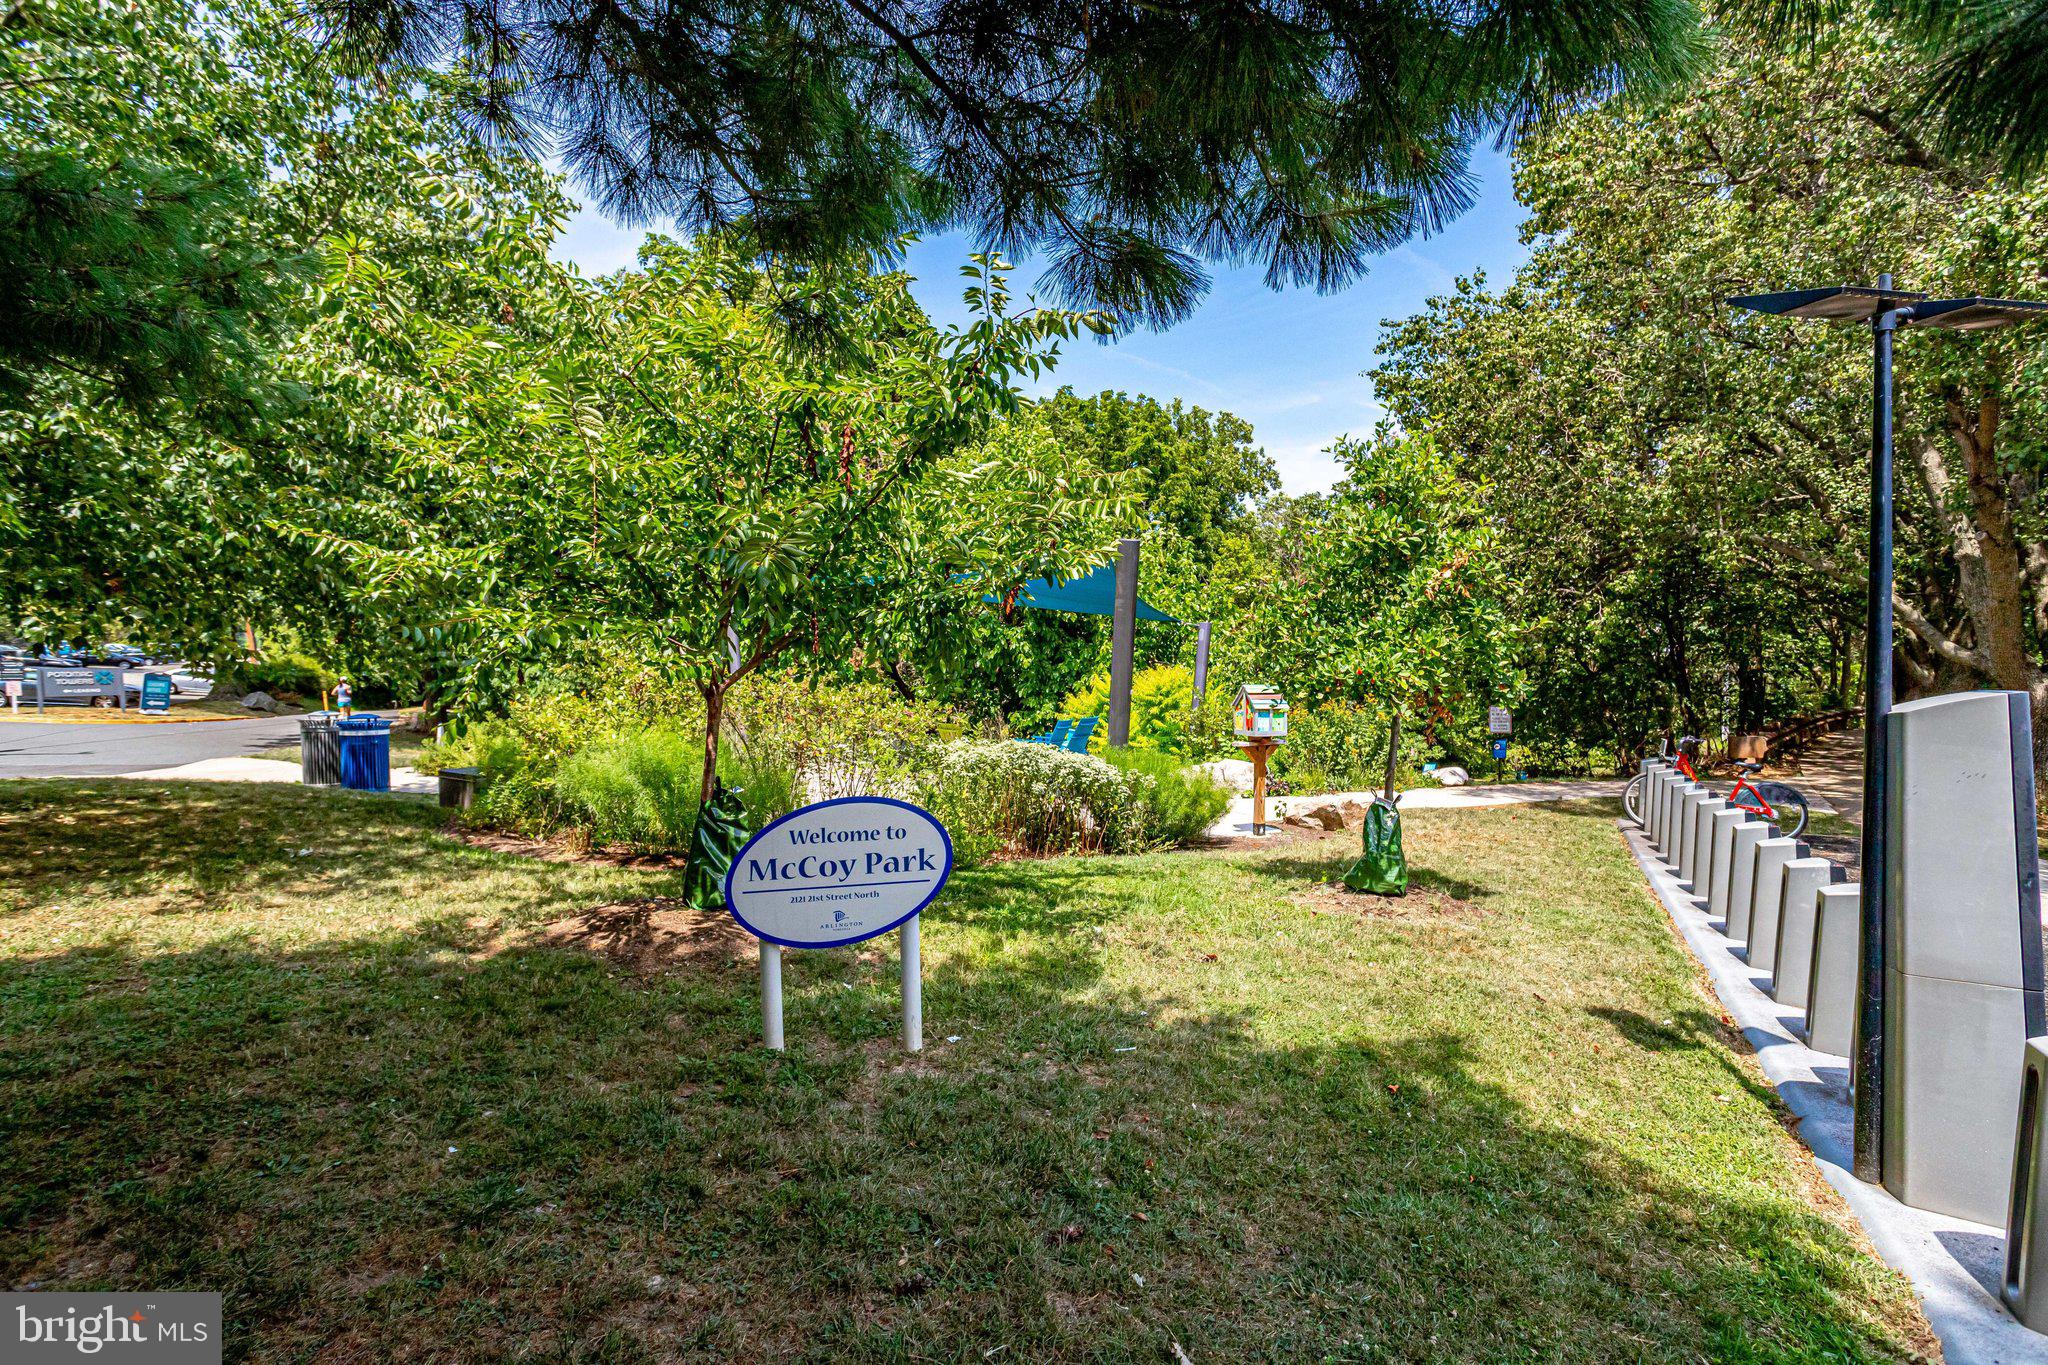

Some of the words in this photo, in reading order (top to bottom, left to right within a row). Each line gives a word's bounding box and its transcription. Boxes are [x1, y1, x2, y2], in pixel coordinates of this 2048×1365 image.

[789, 827, 881, 845] Welcome
[886, 825, 907, 840] to
[748, 855, 857, 882] McCoy
[865, 848, 938, 875] Park
[790, 896, 806, 904] 2121
[807, 894, 824, 902] 21st
[825, 893, 852, 901] Street
[854, 890, 880, 899] North
[820, 921, 864, 929] ARLINGTON
